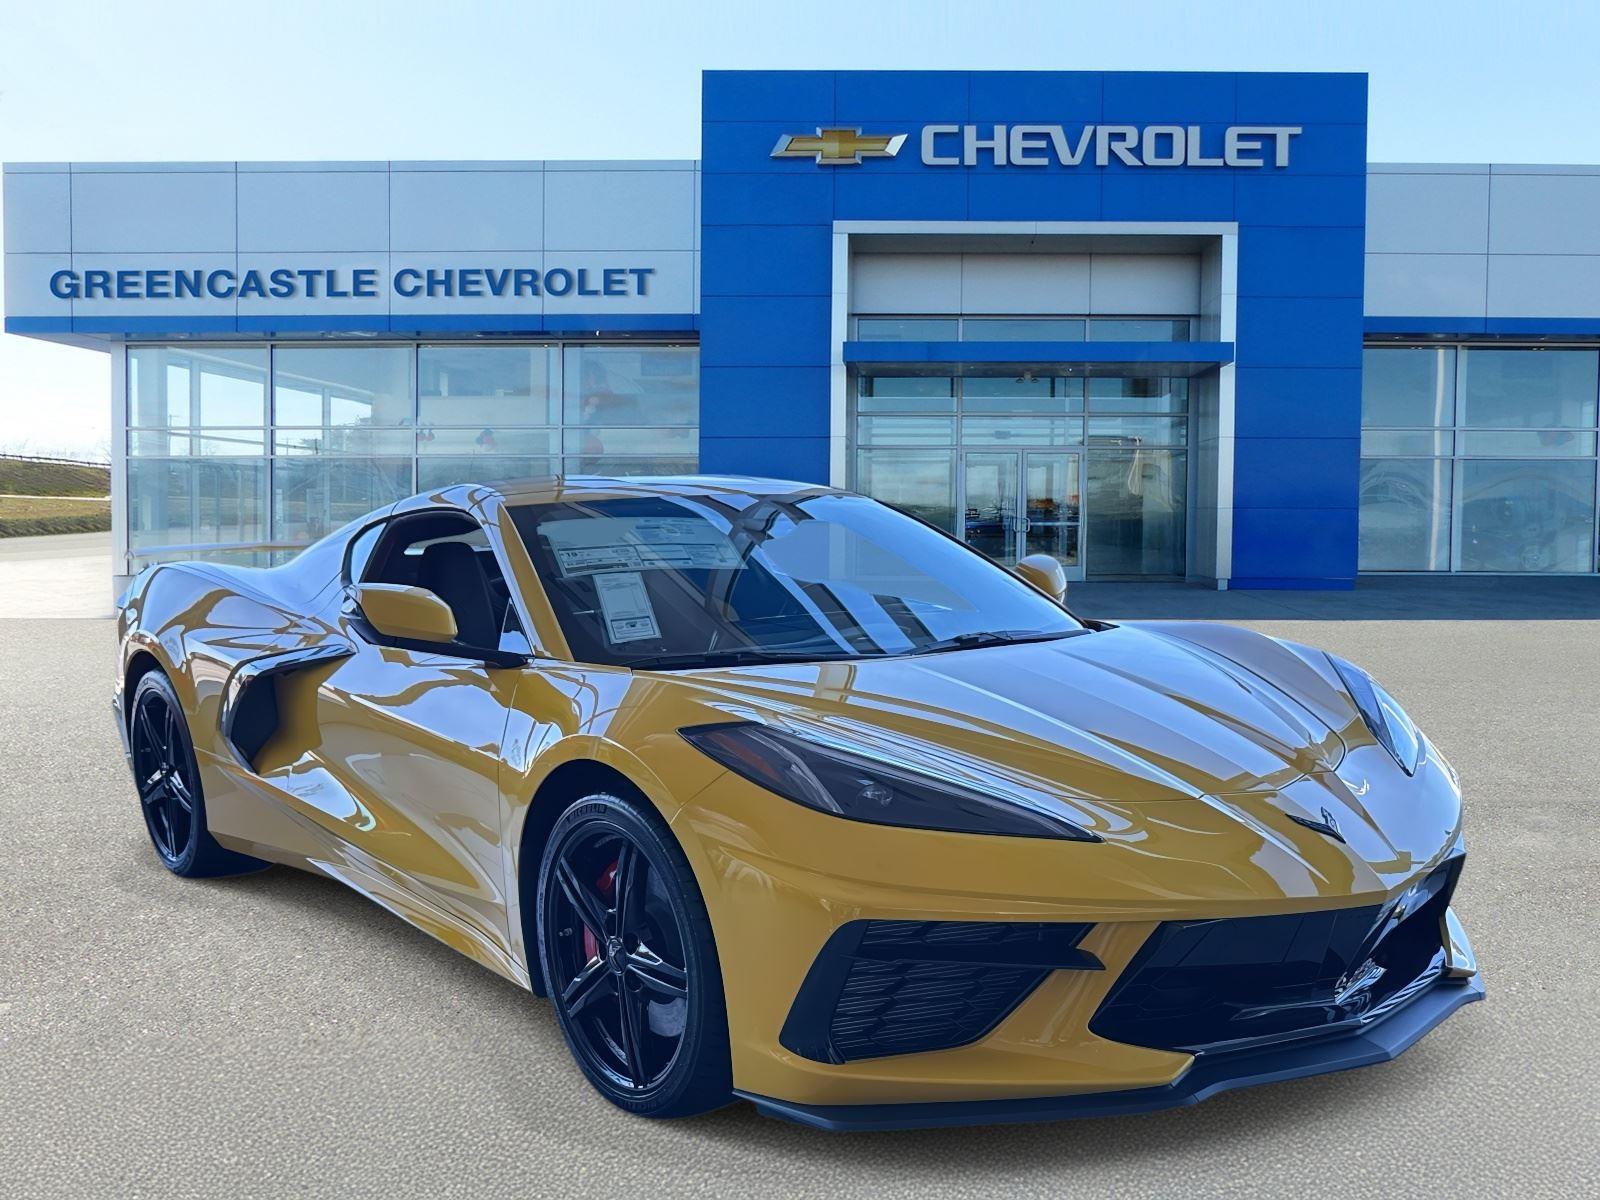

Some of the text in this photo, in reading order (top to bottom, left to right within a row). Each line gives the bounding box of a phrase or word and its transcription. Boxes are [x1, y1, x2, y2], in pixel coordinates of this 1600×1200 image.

[921, 124, 1302, 167] CHEVROLET
[50, 268, 655, 299] GREENCASTLE CHEVROLET
